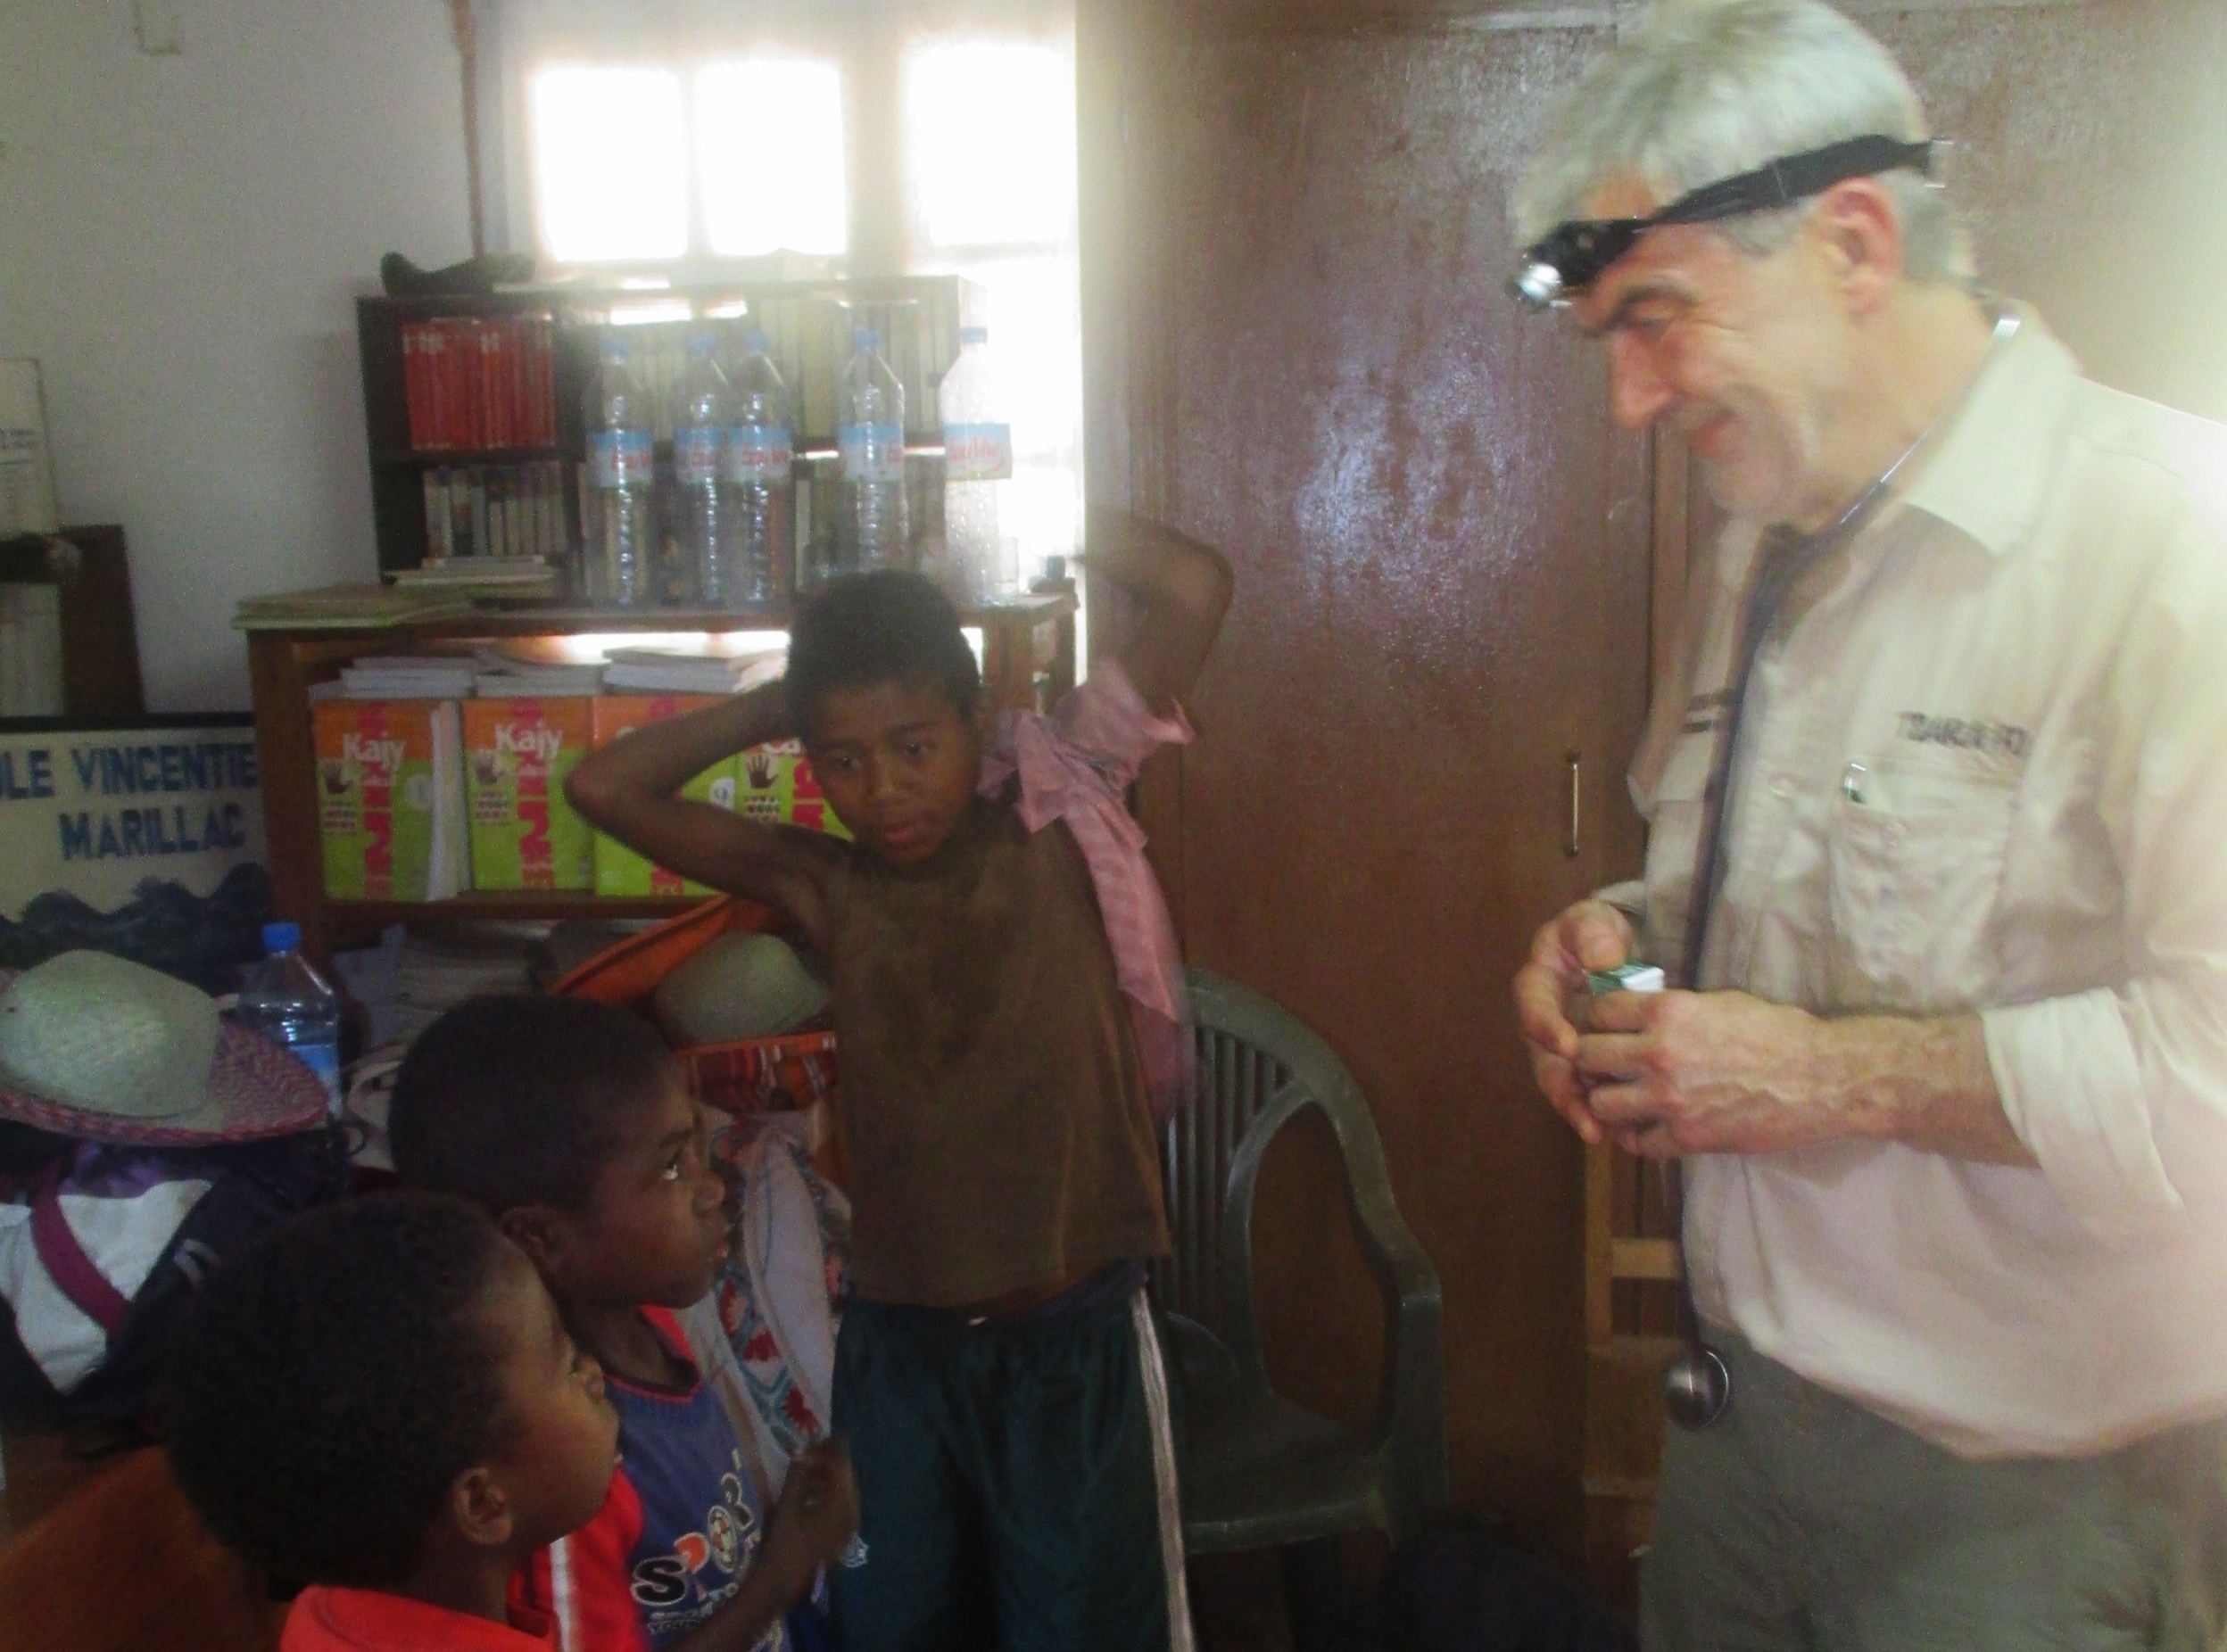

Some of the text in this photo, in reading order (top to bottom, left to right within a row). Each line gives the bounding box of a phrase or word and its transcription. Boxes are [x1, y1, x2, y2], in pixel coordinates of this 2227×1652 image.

[495, 719, 564, 770] Kajy
[0, 748, 54, 800] LE
[58, 802, 245, 862] MARILLAC
